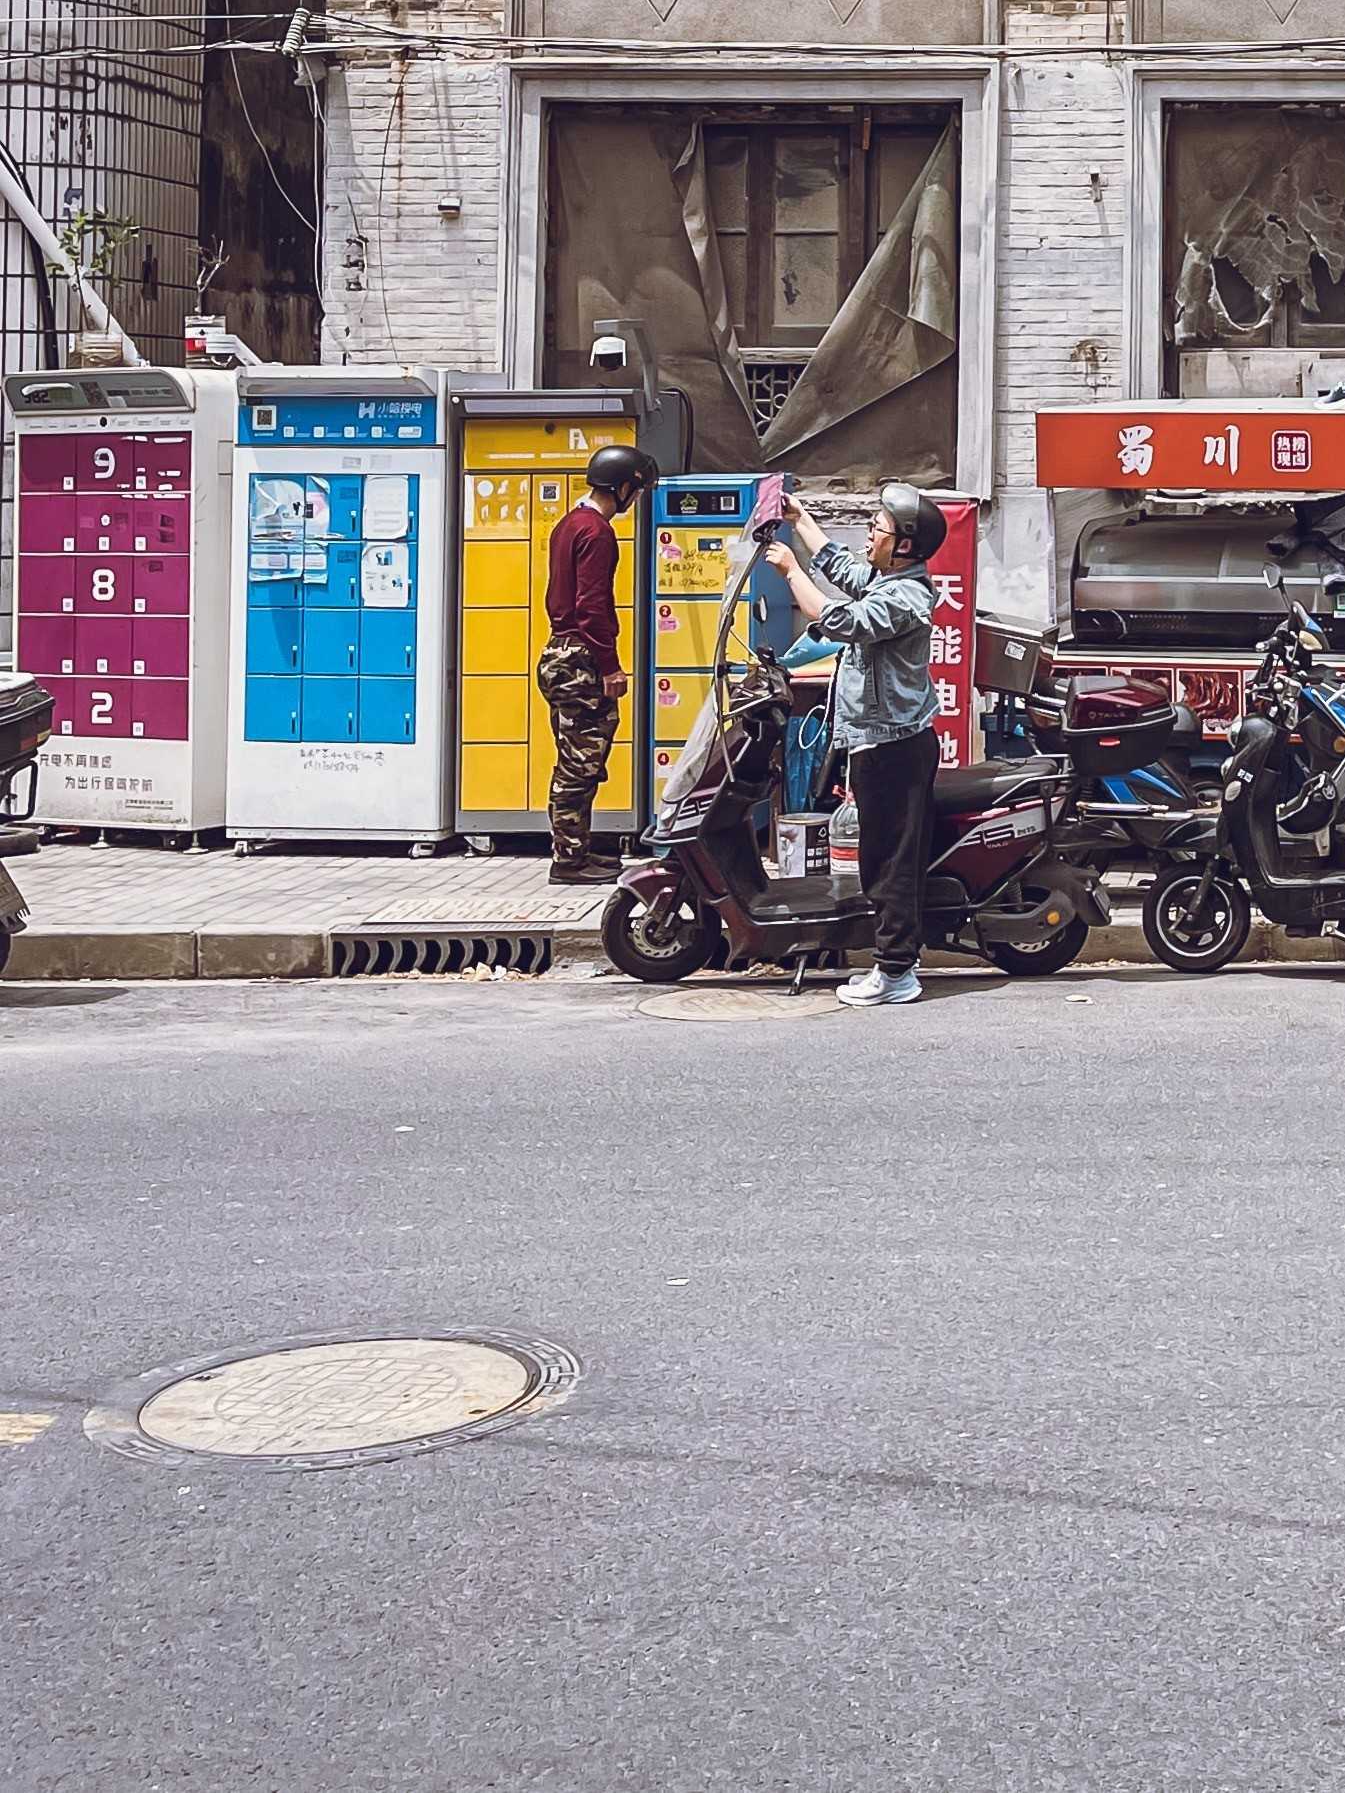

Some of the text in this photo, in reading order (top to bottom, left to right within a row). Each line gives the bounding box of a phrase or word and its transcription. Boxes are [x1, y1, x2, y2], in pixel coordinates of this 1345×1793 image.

[94, 448, 116, 479] 9
[92, 569, 115, 601] 8
[91, 692, 113, 724] 2
